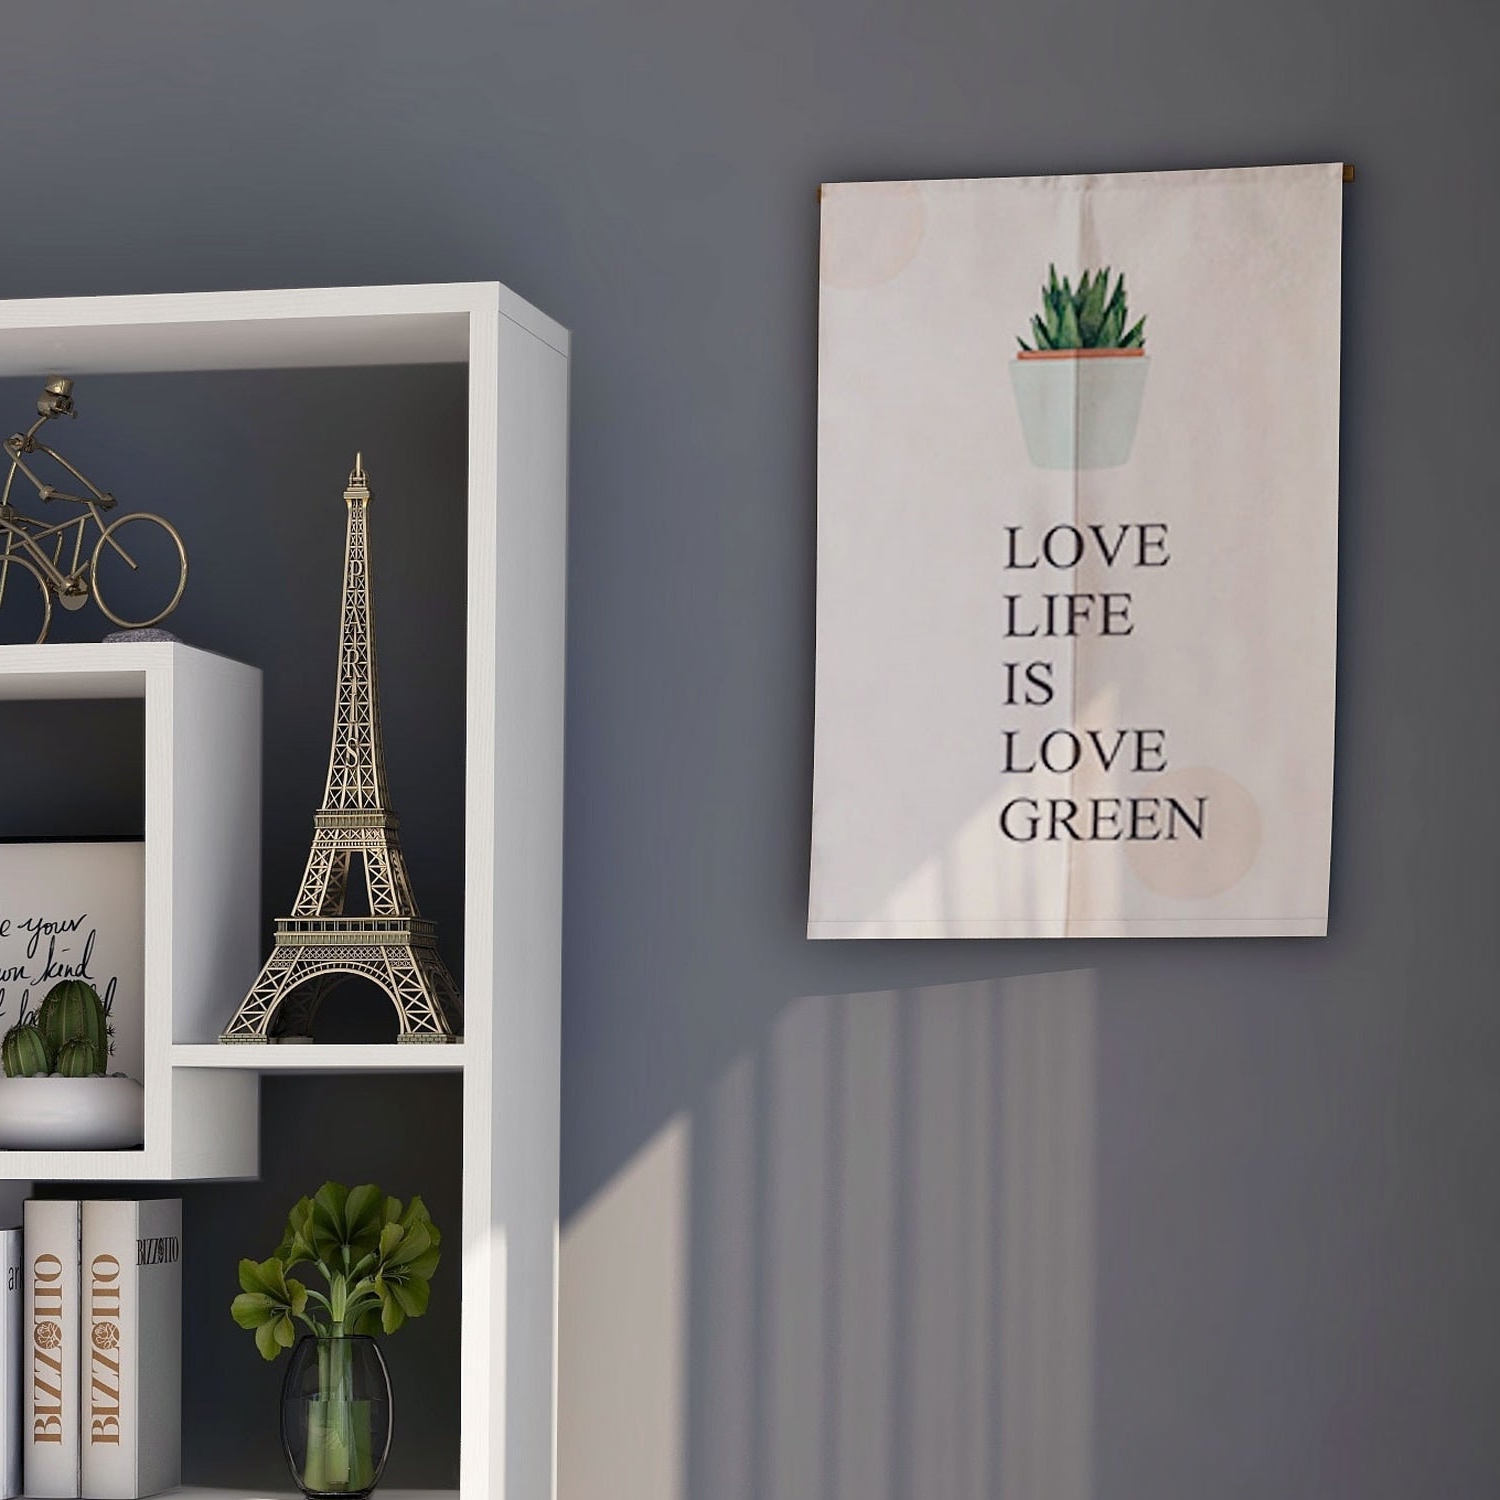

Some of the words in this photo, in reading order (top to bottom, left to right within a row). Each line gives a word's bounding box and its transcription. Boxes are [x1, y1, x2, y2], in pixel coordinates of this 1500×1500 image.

[1003, 524, 1171, 570] LOVE
[1003, 593, 1135, 637] LIFE
[1003, 661, 1055, 705] IS
[1001, 729, 1167, 774] LOVE
[999, 796, 1209, 842] GREEN
[17, 913, 88, 959] your
[30, 929, 97, 986] kind
[33, 1253, 63, 1446] BIZZOTTO
[91, 1253, 120, 1446] BIZZOTTO
